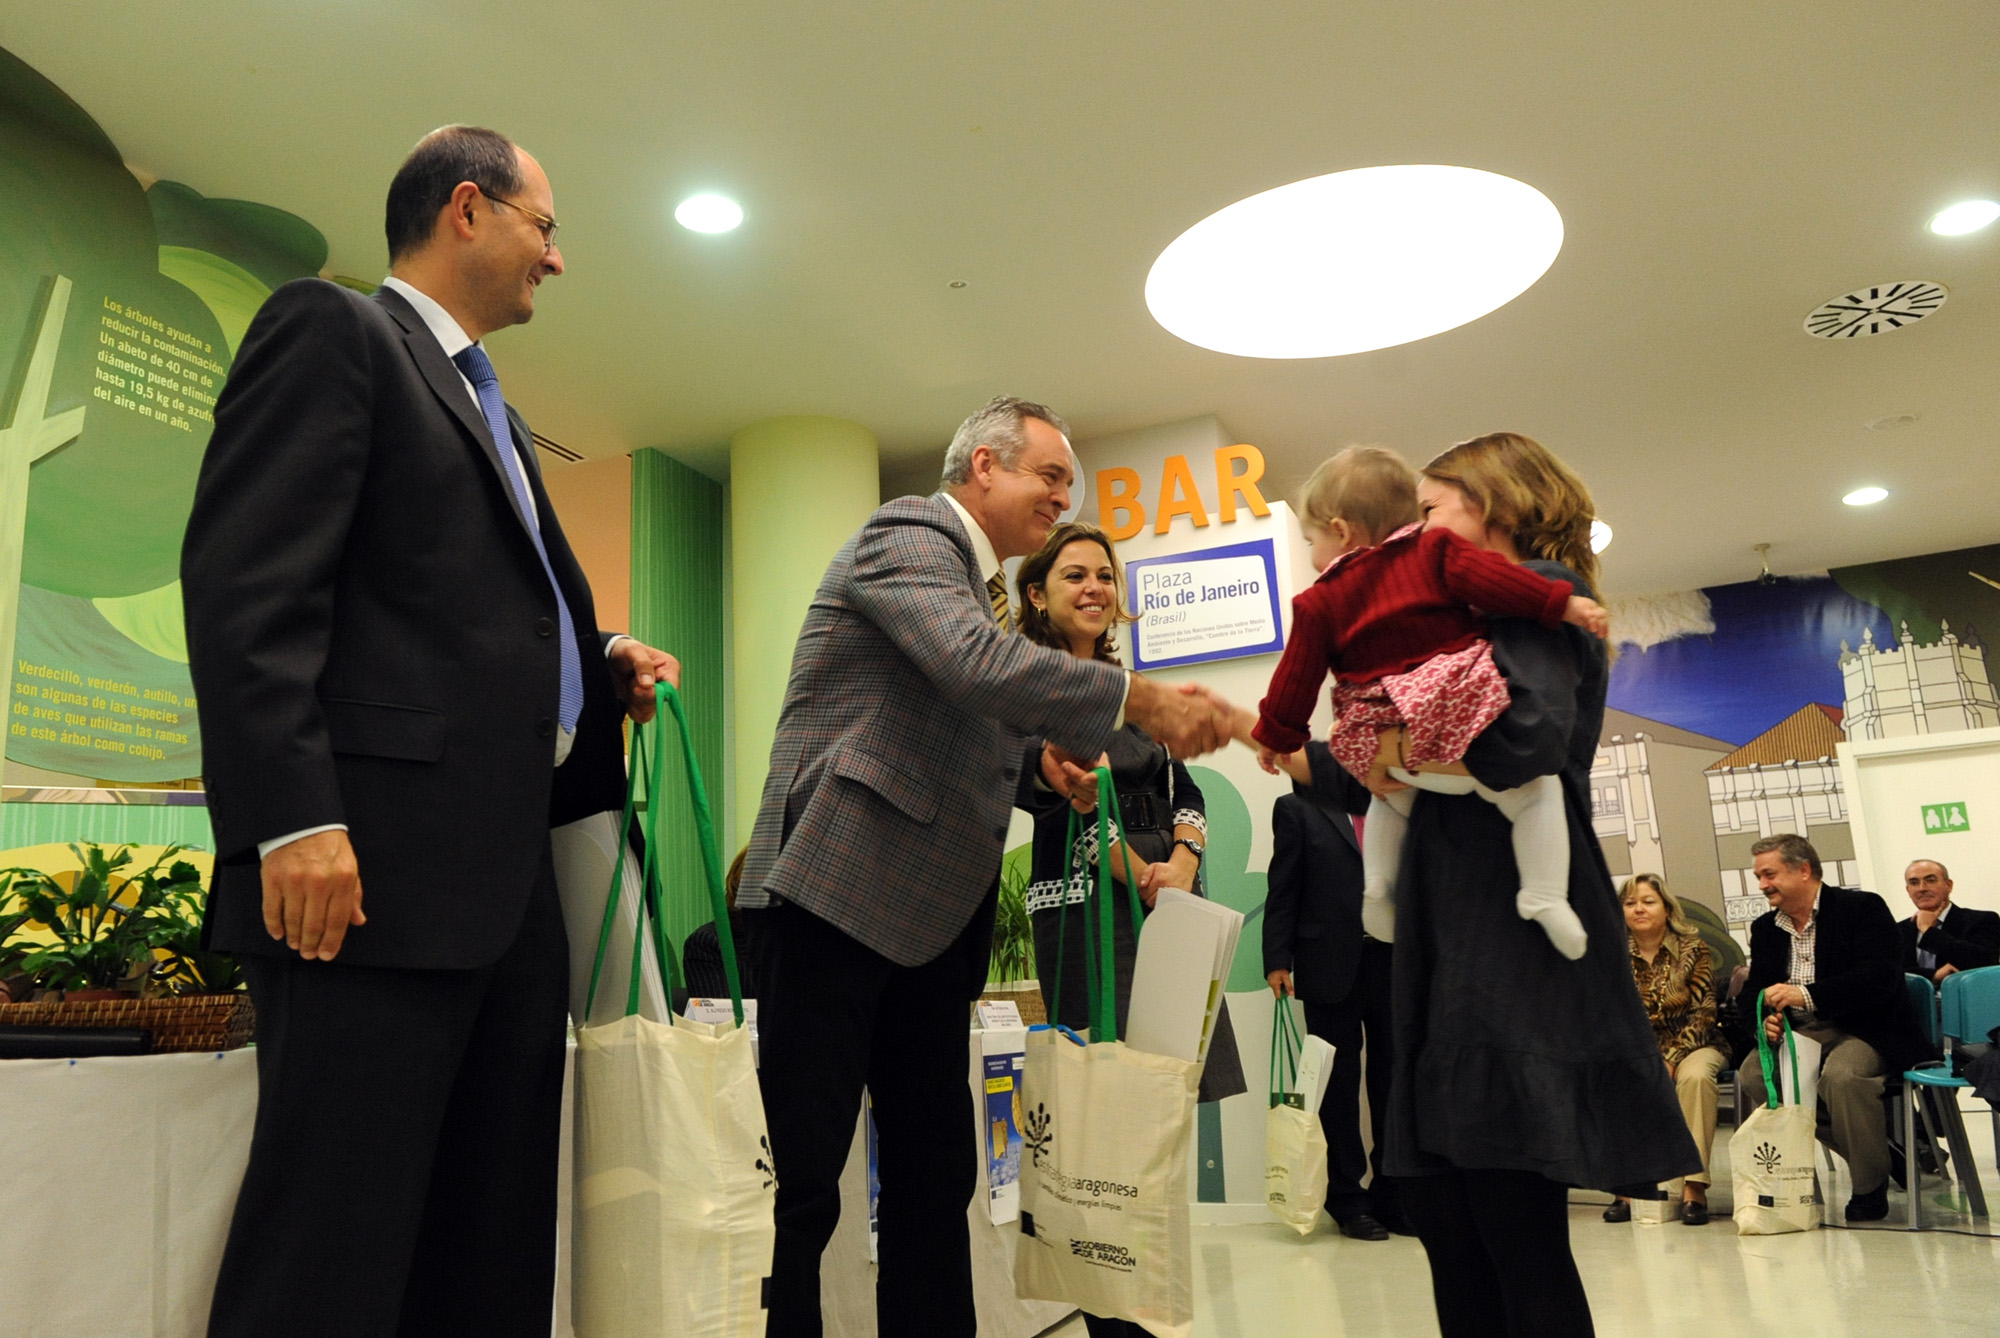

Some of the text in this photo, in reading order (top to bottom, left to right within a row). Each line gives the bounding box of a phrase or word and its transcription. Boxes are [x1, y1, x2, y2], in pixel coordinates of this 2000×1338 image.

[102, 315, 226, 377] reducir la contaminación.
[104, 296, 212, 353] Los árboles ayudan a
[98, 350, 145, 378] diámetro
[148, 370, 179, 392] puede
[100, 332, 213, 388] Un abeto de 40 cm de
[93, 385, 192, 433] del aire en un año.
[96, 367, 125, 388] hasta
[130, 379, 154, 400] 19,5
[156, 389, 170, 408] kg
[172, 397, 185, 412] de
[1096, 443, 1272, 542] BAR
[1143, 571, 1192, 591] Plaza
[1144, 579, 1260, 611] Río de Janeiro
[1146, 611, 1187, 628] (Brasil)
[15, 682, 179, 725] son algunas de las especies
[18, 659, 84, 688] Verdecillo,
[87, 676, 141, 699] verderón,
[143, 687, 181, 708] autillo,
[11, 722, 166, 761] de este árbol como cobijo.
[13, 701, 188, 745] de aves que utilizan las ramas
[1081, 1240, 1129, 1257] GOBIERNO
[1083, 1250, 1094, 1260] DE
